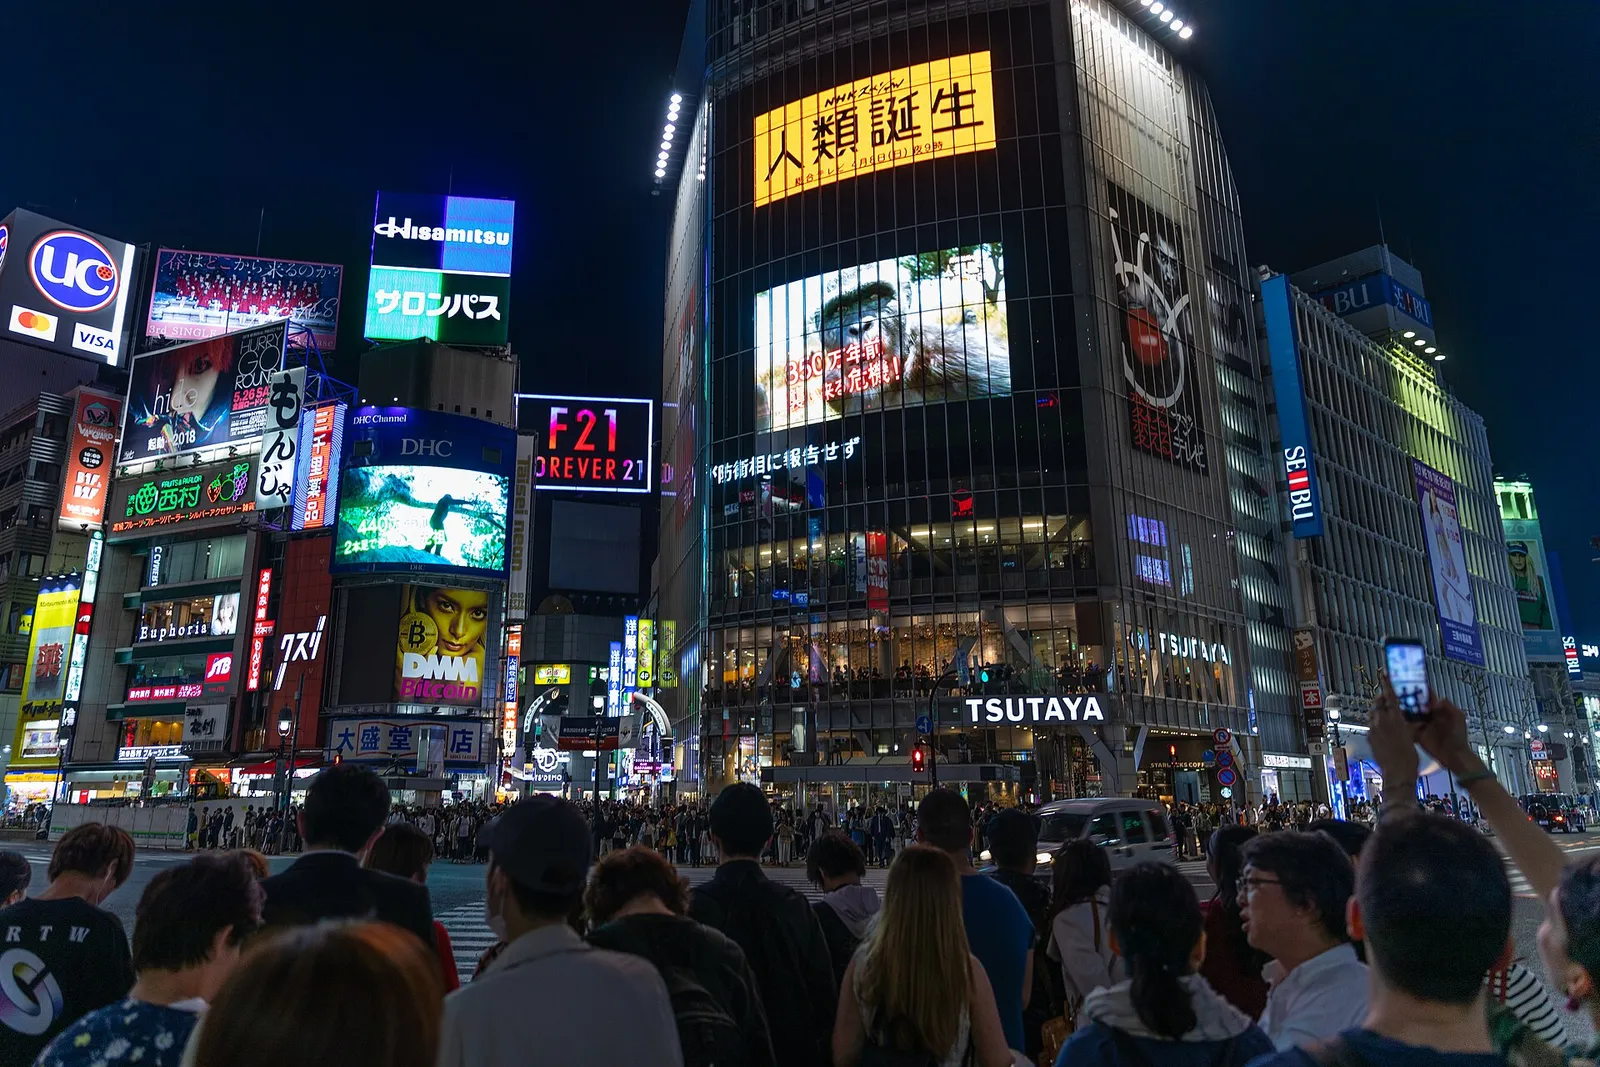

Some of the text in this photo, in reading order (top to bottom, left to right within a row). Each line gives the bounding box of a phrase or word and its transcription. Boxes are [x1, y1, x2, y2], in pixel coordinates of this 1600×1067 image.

[763, 82, 985, 183] 人類誕生
[374, 216, 510, 246] Hisamitsu
[374, 288, 501, 321] サロンパス
[80, 330, 115, 350] VISA
[149, 325, 218, 337] 3rd SINGLE
[240, 331, 284, 355] HURRY
[237, 344, 281, 376] GO
[152, 378, 198, 415] hide
[77, 422, 114, 442] VANGUARD
[352, 413, 407, 425] DHC Channel
[548, 406, 618, 453] F21
[172, 430, 196, 447] 2018
[259, 372, 299, 504] もんじゃ
[400, 438, 453, 458] DHC
[1172, 436, 1206, 468] テレビ
[304, 410, 330, 521] 三千里薬品
[622, 458, 644, 481] 21
[1284, 445, 1314, 521] SEIBU
[157, 484, 202, 512] 西村
[139, 621, 208, 642] Euphoria
[35, 642, 64, 677] 薬
[207, 656, 232, 679] JTB
[402, 651, 479, 682] DMM
[1561, 635, 1581, 673] SEIBU
[400, 678, 478, 700] Bitcoin
[1304, 690, 1320, 705] 本
[965, 696, 1105, 723] TSUTAYA
[337, 725, 475, 754] 大盛堂店
[5, 925, 91, 943] R T W
